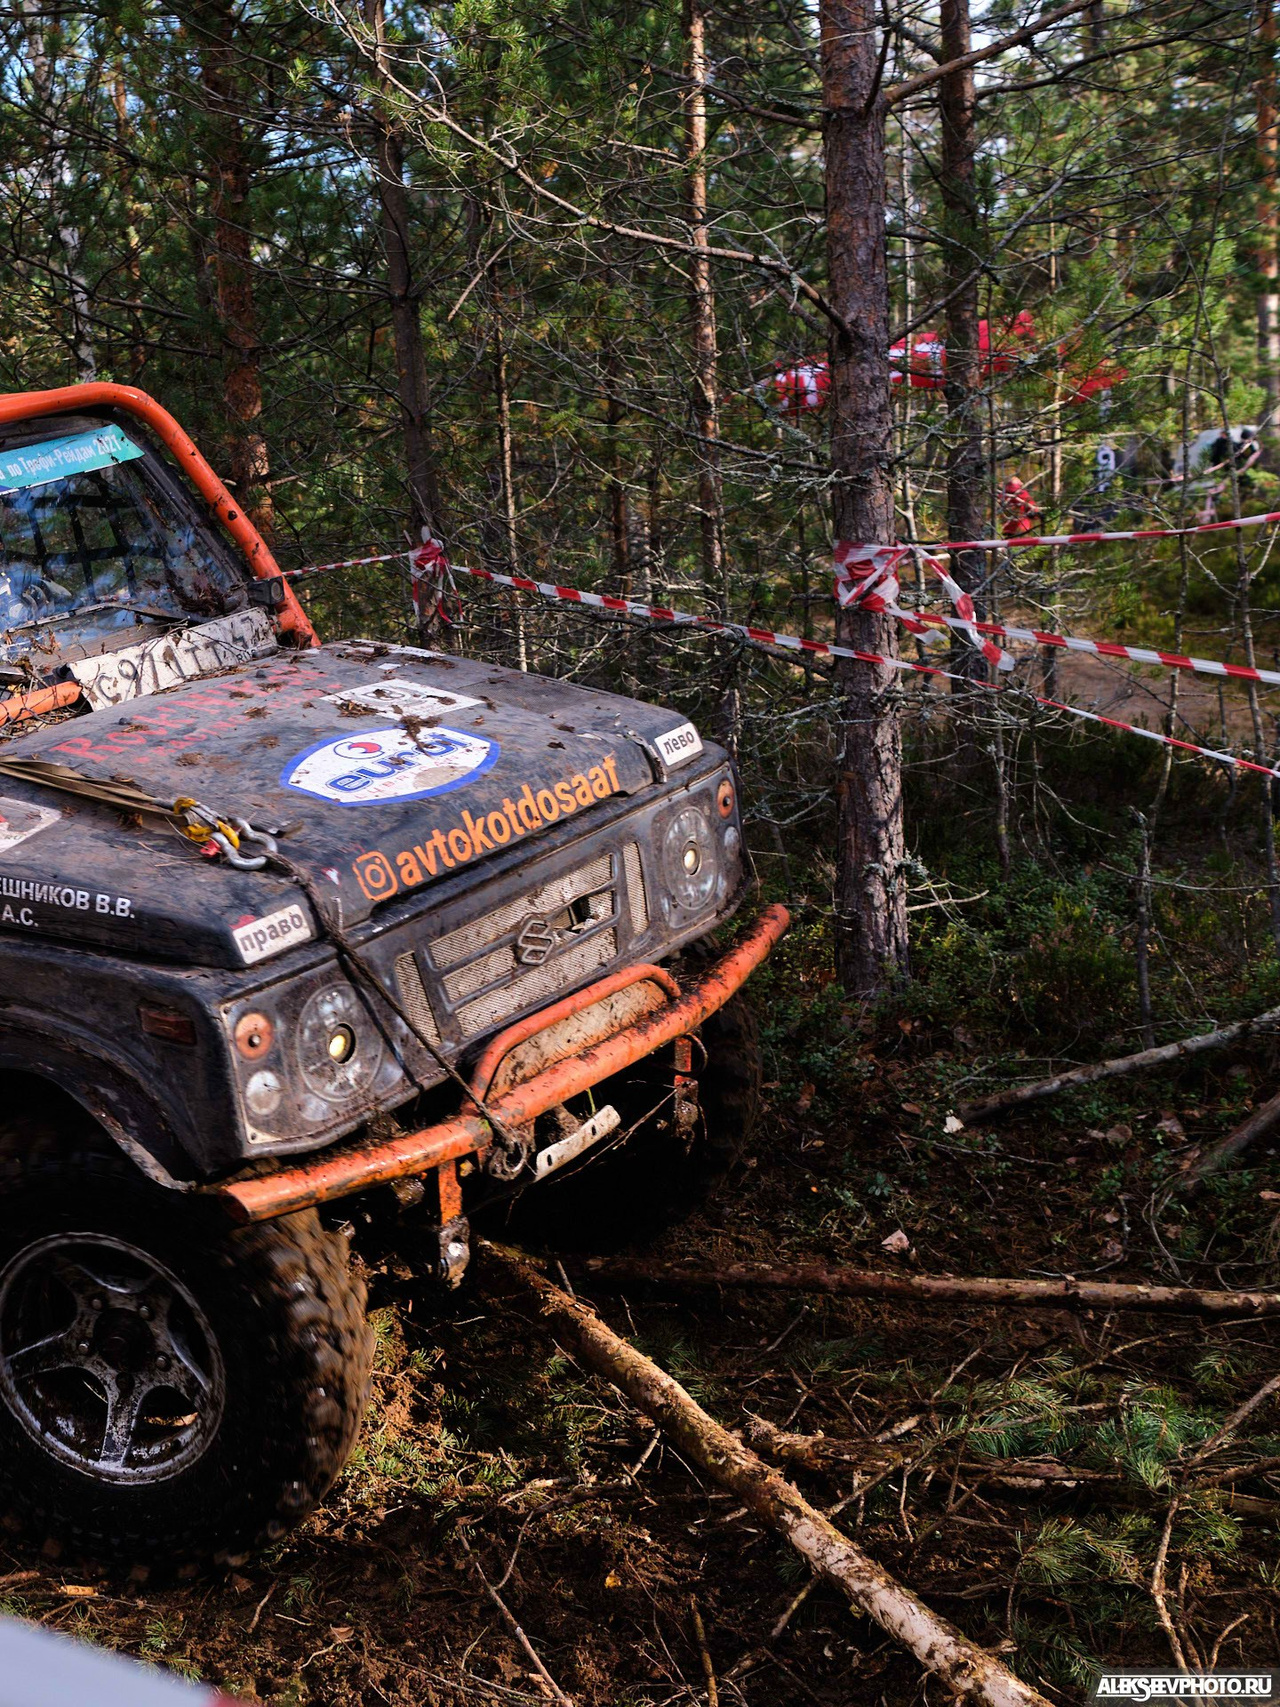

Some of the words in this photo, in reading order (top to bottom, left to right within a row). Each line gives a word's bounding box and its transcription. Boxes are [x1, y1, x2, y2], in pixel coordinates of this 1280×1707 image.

[6, 462, 22, 478] по
[663, 731, 695, 755] лево
[395, 754, 621, 886] avtokotdosaaf
[1, 903, 39, 927] А.С.
[95, 893, 136, 919] В.В.
[239, 913, 303, 952] право
